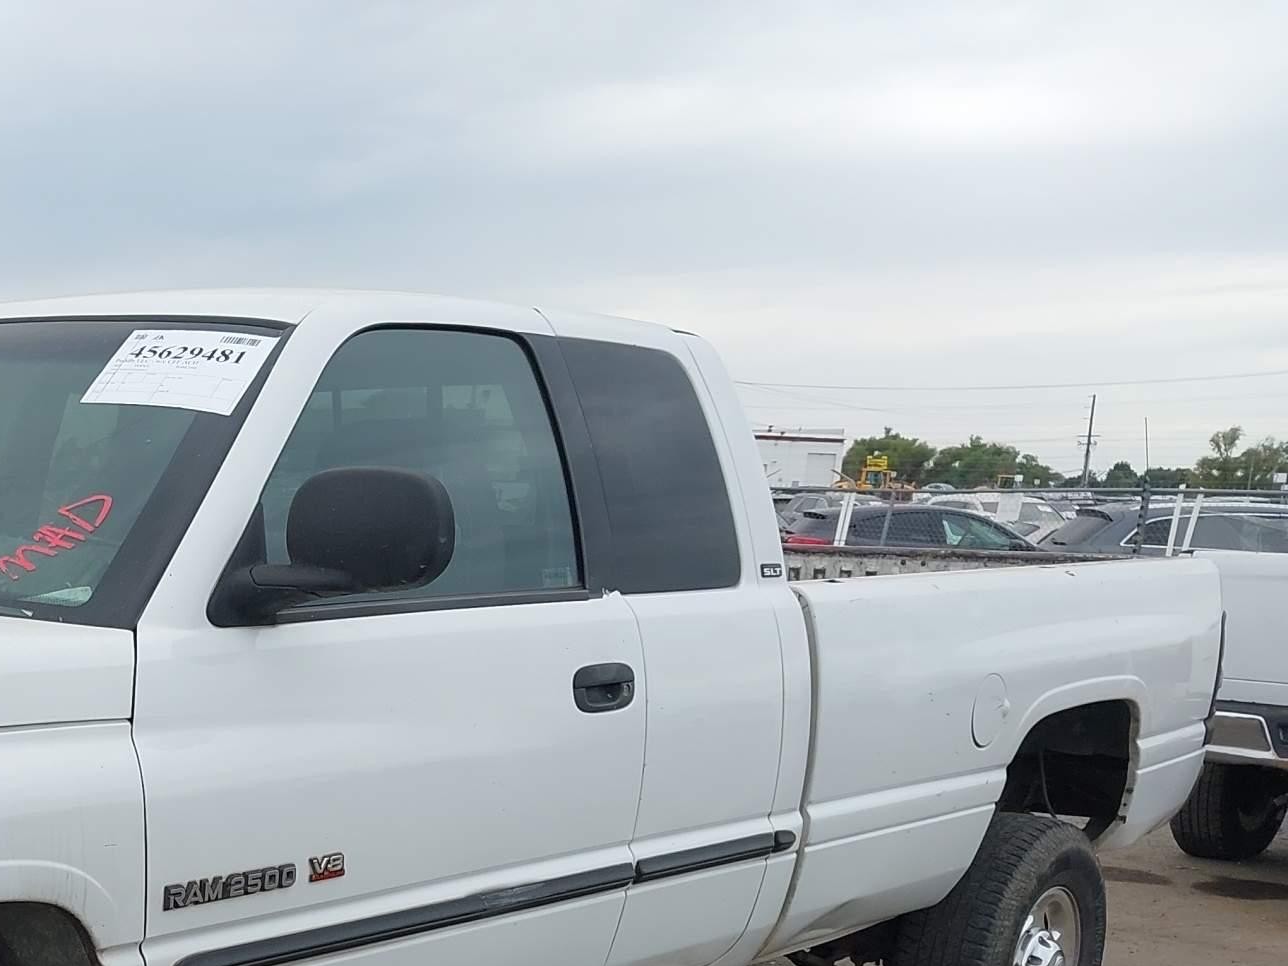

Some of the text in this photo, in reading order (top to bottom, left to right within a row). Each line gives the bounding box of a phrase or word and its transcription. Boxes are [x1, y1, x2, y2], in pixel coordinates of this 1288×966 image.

[129, 345, 248, 365] 45629481
[763, 567, 781, 576] SLT
[164, 853, 345, 910] RAM 2500 V8
